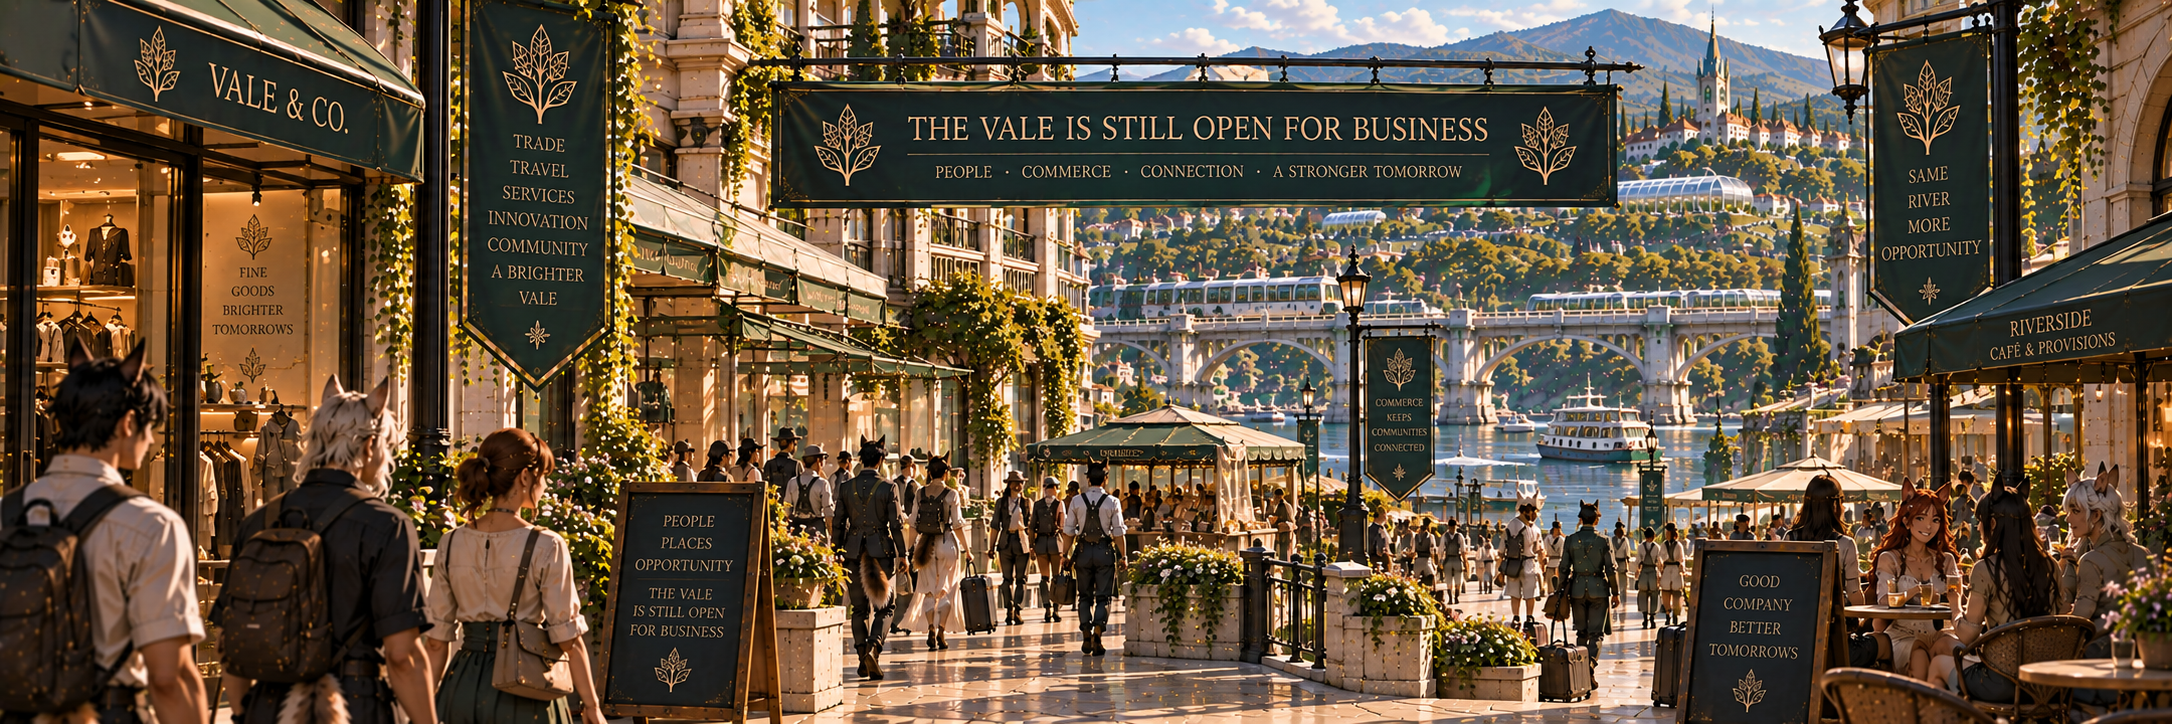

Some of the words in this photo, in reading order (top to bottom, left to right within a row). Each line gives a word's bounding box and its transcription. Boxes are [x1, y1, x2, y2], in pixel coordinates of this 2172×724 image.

[208, 62, 277, 112] VALE
[286, 89, 304, 121] &
[313, 97, 348, 134] CO.
[908, 117, 968, 140] THE
[980, 117, 1054, 140] VALE
[1066, 116, 1090, 140] IS
[1103, 116, 1183, 140] STILL
[1194, 116, 1272, 140] OPEN
[1284, 117, 1342, 140] FOR
[1354, 117, 1487, 141] BUSINESS
[514, 134, 564, 152] TRADE
[510, 160, 568, 178] TRAVEL
[936, 166, 992, 178] PEOPLE
[1022, 165, 1111, 178] COMMERCE
[1141, 165, 1243, 178] CONNECTION
[1273, 166, 1283, 177] A
[1289, 165, 1368, 178] STRONGER
[1374, 165, 1462, 178] TOMORROW
[1909, 166, 1948, 183] SAME
[503, 186, 574, 204] SERVICES
[1909, 192, 1950, 208] RIVER
[489, 210, 588, 230] INNOVATION
[1908, 217, 1950, 233] MORE
[488, 237, 588, 256] COMMUNITY
[1882, 240, 1981, 261] OPPORTUNITY
[240, 267, 267, 278] FINE
[492, 265, 502, 278] A
[508, 265, 583, 282] BRIGHTER
[232, 285, 274, 296] GOODS
[520, 291, 557, 305] VALE
[223, 305, 283, 315] BRIGHTER
[212, 324, 293, 335] TOMORROWS
[2009, 309, 2092, 337] RIVERSIDE
[1990, 342, 2020, 360] CAFÉ
[2025, 343, 2034, 356] &
[2038, 331, 2116, 353] PROVISIONS
[1376, 398, 1423, 407] COMMERCE
[1387, 413, 1411, 421] KEEPS
[1372, 428, 1427, 436] COMMUNITIES
[664, 515, 714, 527] PEOPLE
[661, 537, 712, 549] PLACES
[635, 559, 733, 571] OPPORTUNITY
[1740, 575, 1780, 587] GOOD
[649, 588, 675, 599] THE
[681, 588, 712, 600] VALE
[1724, 597, 1792, 611] COMPANY
[634, 605, 645, 616] IS
[649, 606, 684, 617] STILL
[689, 607, 725, 618] OPEN
[630, 624, 655, 636] FOR
[661, 625, 723, 638] BUSINESS
[1730, 621, 1780, 635] BETTER
[1709, 644, 1798, 659] TOMORROWS
